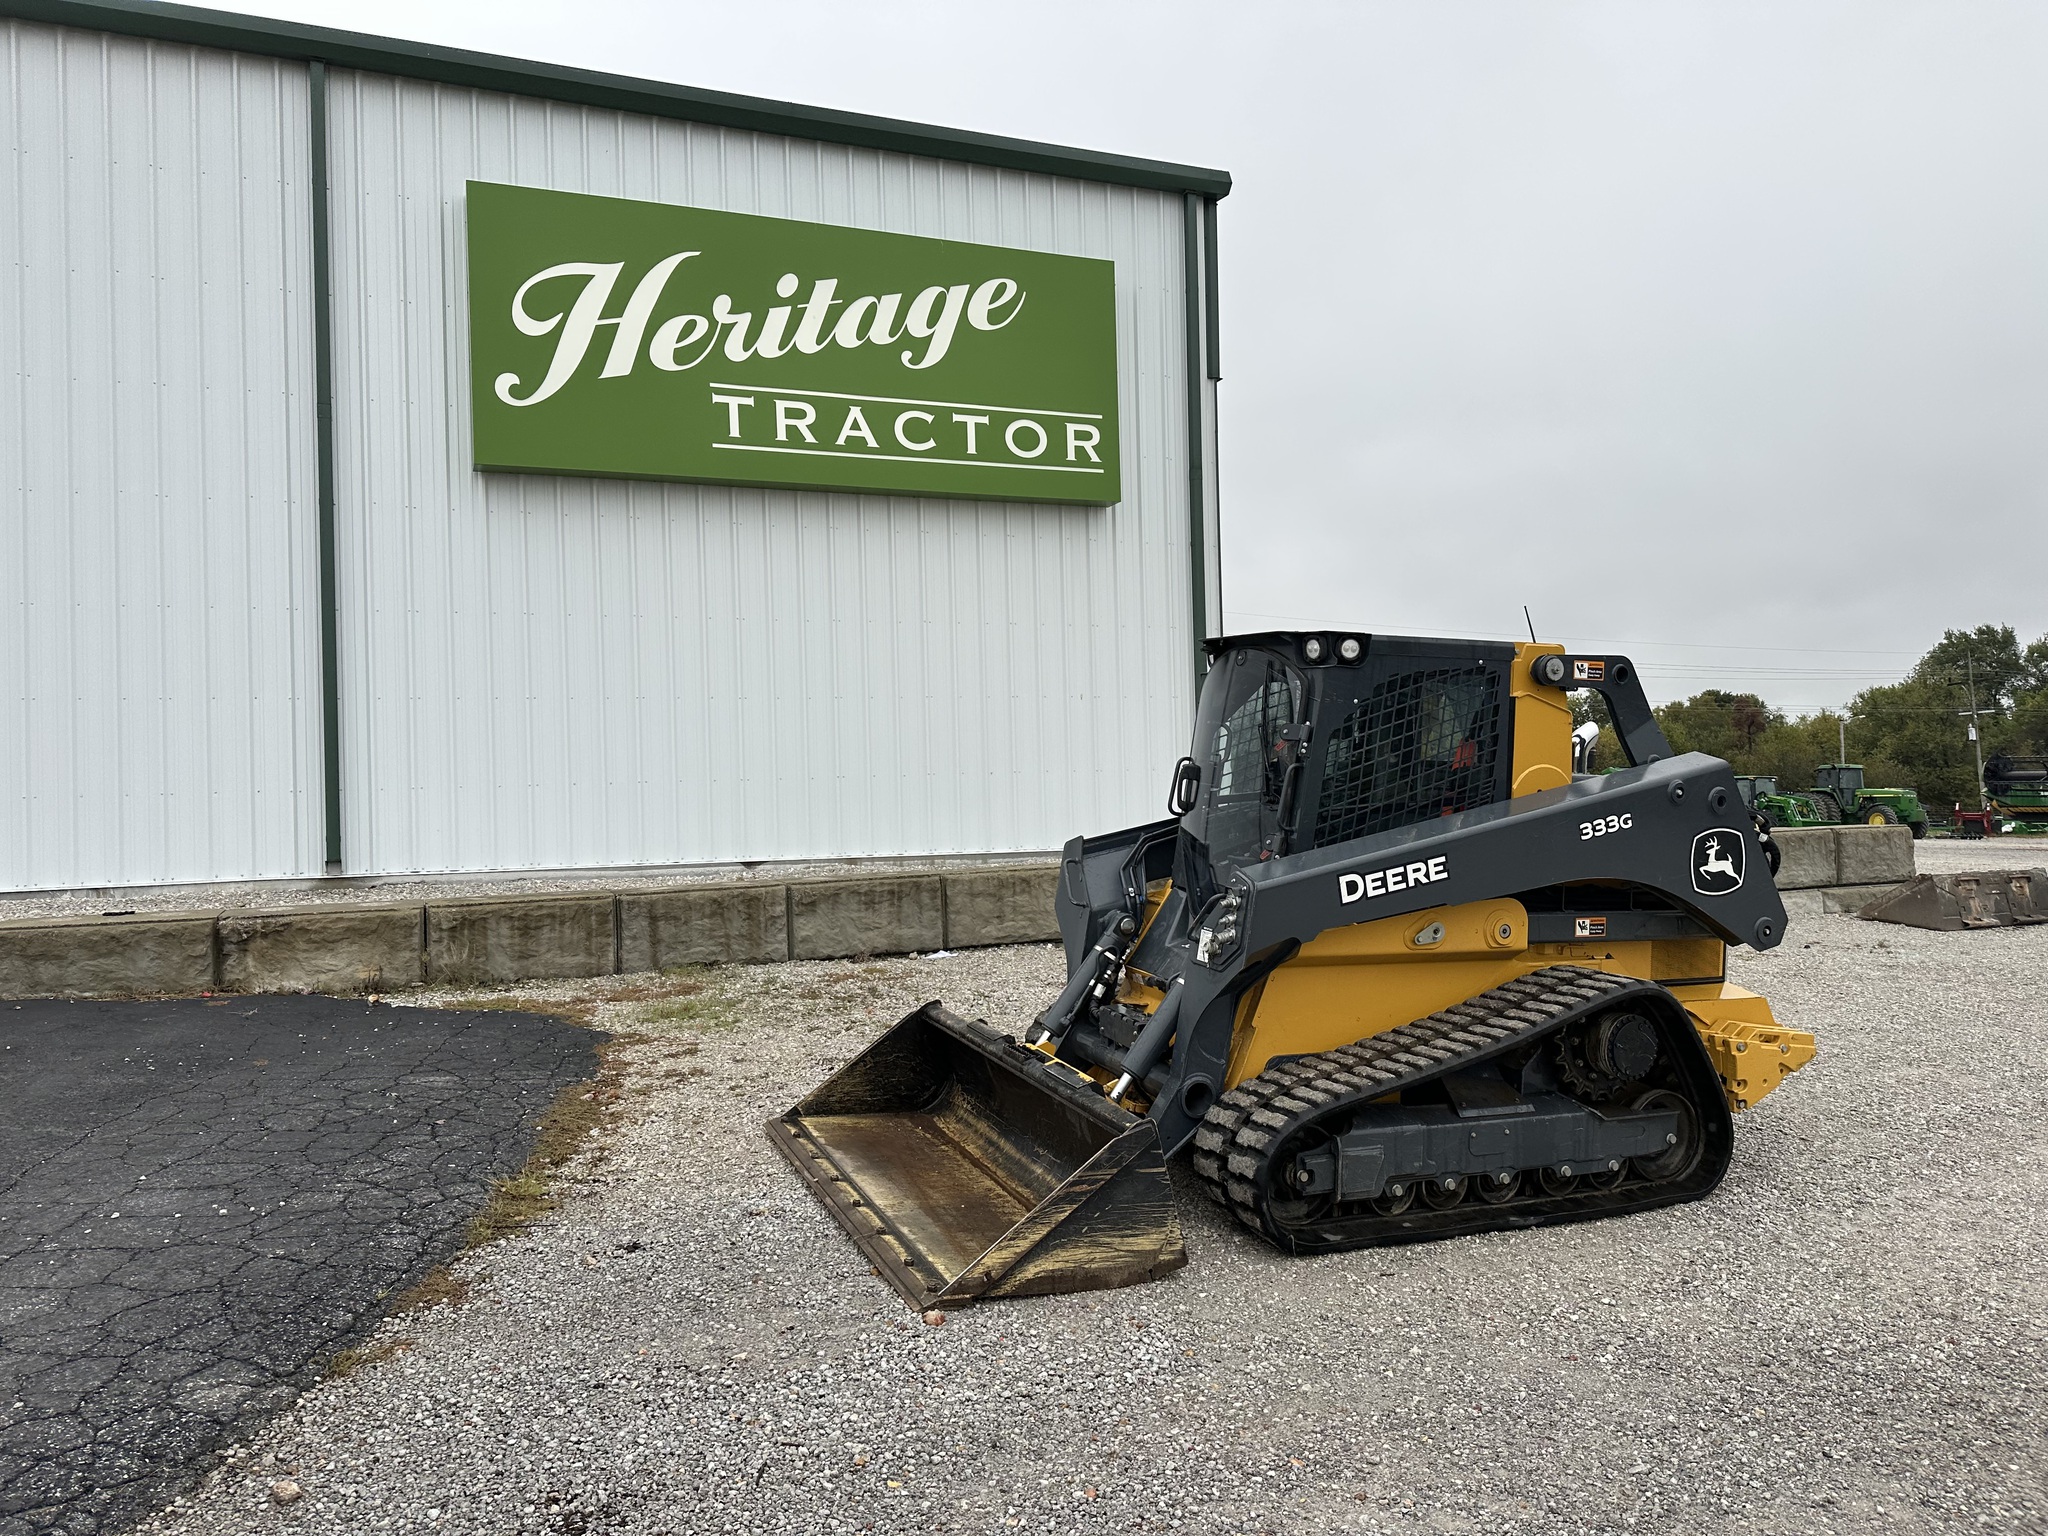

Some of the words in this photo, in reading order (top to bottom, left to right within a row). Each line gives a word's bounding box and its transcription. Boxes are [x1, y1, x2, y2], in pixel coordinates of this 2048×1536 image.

[494, 251, 1027, 407] Heritage
[711, 392, 1103, 463] TRACTOR
[1579, 813, 1633, 840] 333G
[1338, 855, 1449, 904] DEERE
